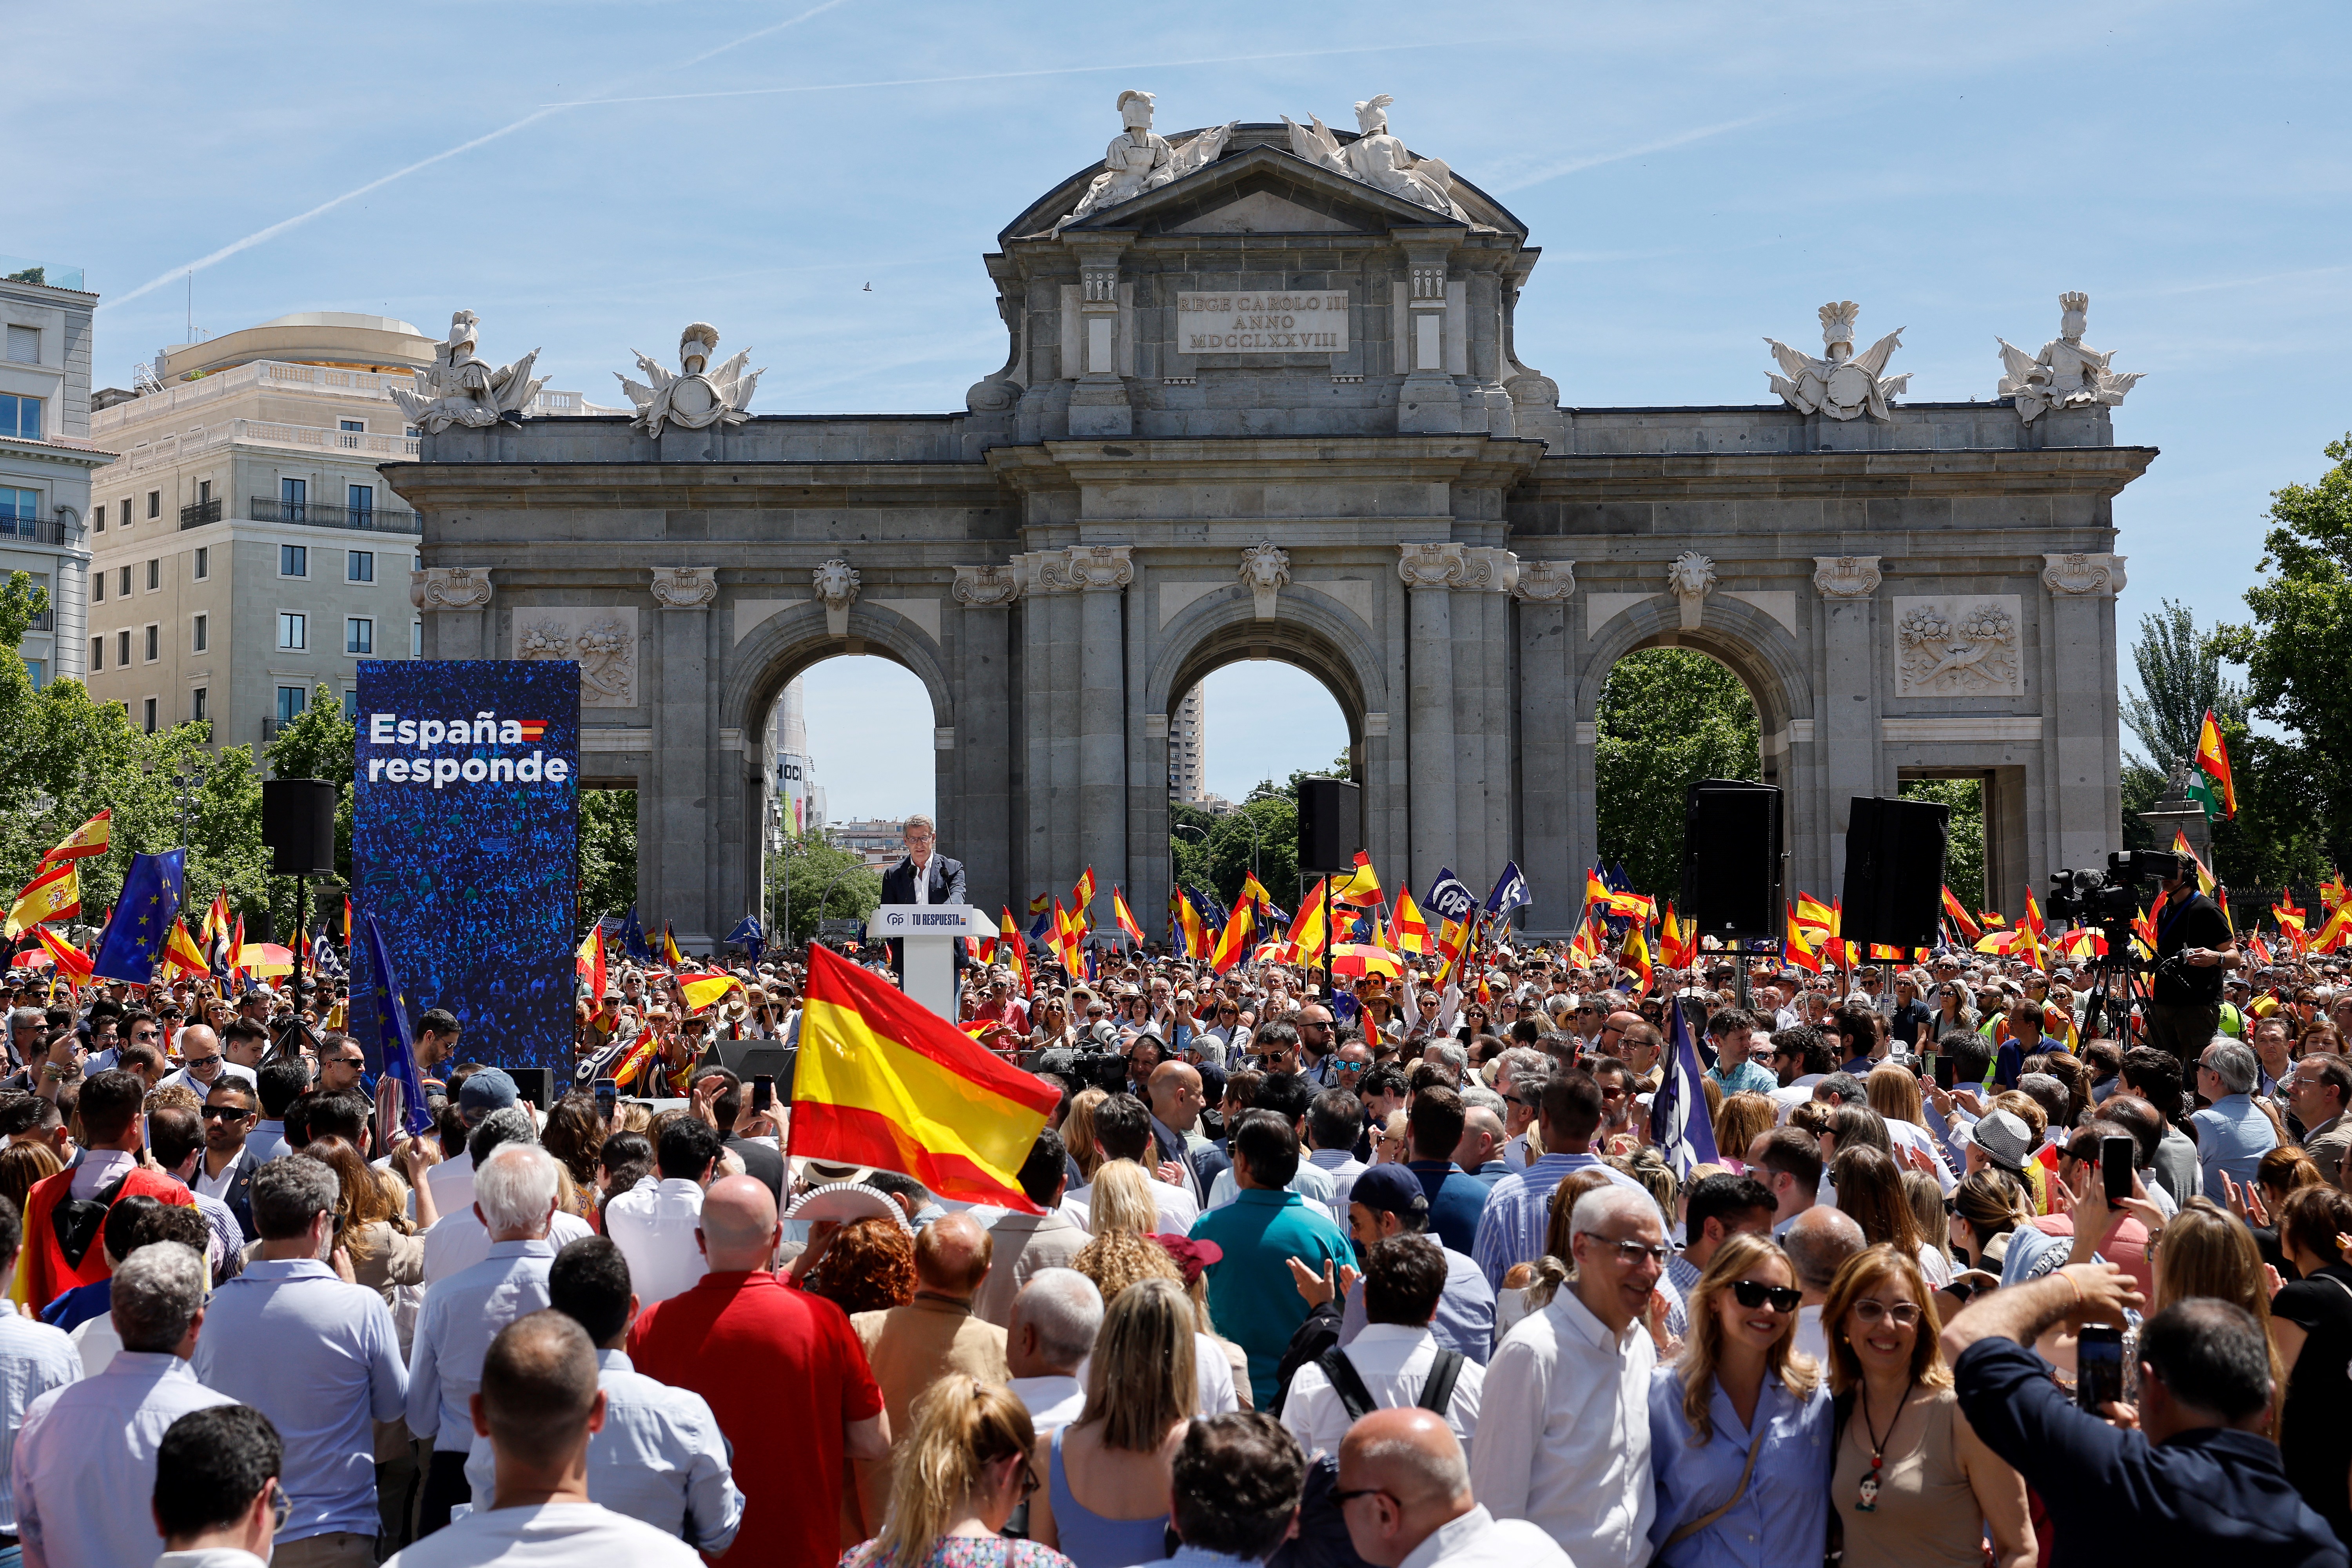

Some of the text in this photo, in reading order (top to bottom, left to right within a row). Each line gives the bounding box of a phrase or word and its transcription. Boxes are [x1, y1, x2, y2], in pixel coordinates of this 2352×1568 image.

[1178, 296, 1348, 311] REGE CAROLO III
[1233, 315, 1295, 328] ANNO
[1190, 333, 1337, 348] MDCCLXXVIII
[370, 711, 522, 750] España
[368, 750, 569, 789] responde
[912, 914, 921, 925] TU
[922, 914, 960, 926] RESPUESTA
